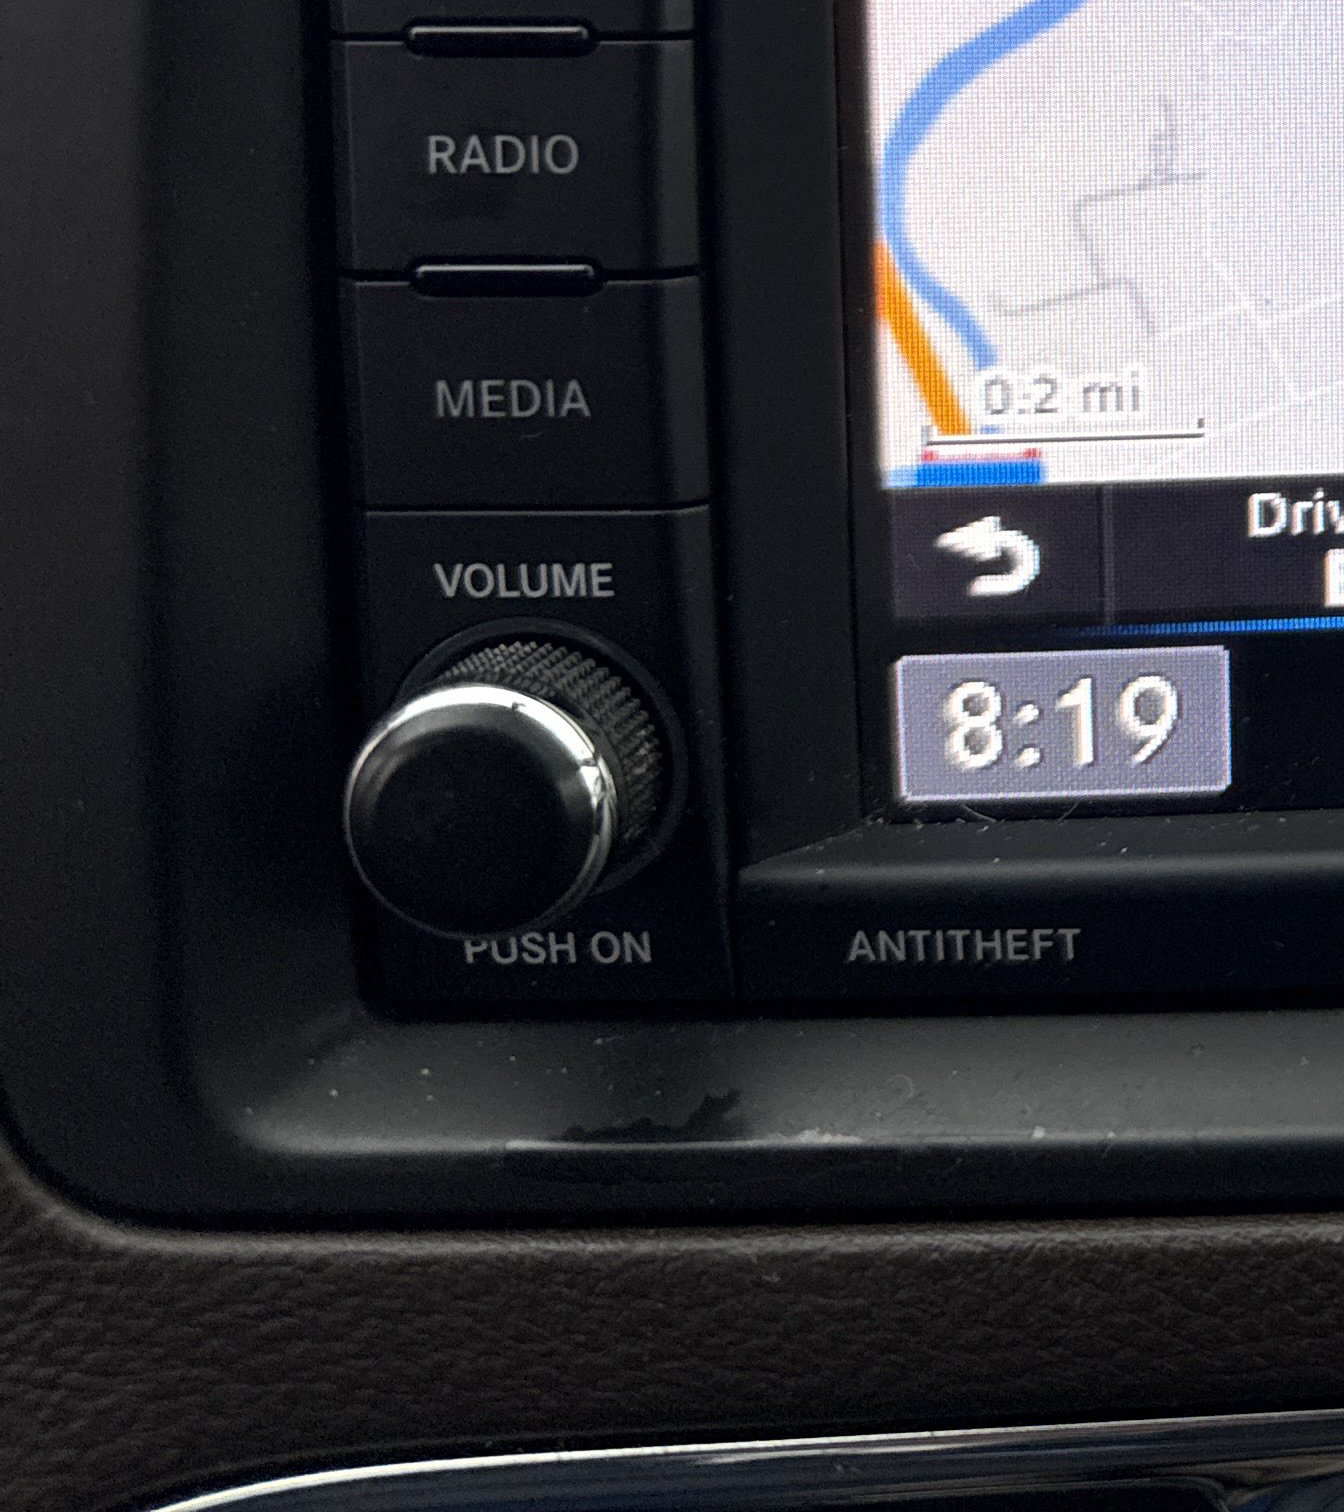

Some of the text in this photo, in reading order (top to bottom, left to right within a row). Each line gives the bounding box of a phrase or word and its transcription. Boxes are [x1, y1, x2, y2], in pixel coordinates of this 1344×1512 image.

[427, 133, 580, 175] RADIO
[435, 379, 592, 420] MEDIA
[983, 369, 1140, 416] 0.2 mi
[434, 563, 615, 600] VOLUME
[946, 675, 1179, 770] 8:19
[463, 930, 653, 965] PUSH ON
[847, 928, 1081, 964] ANTITHEFT
